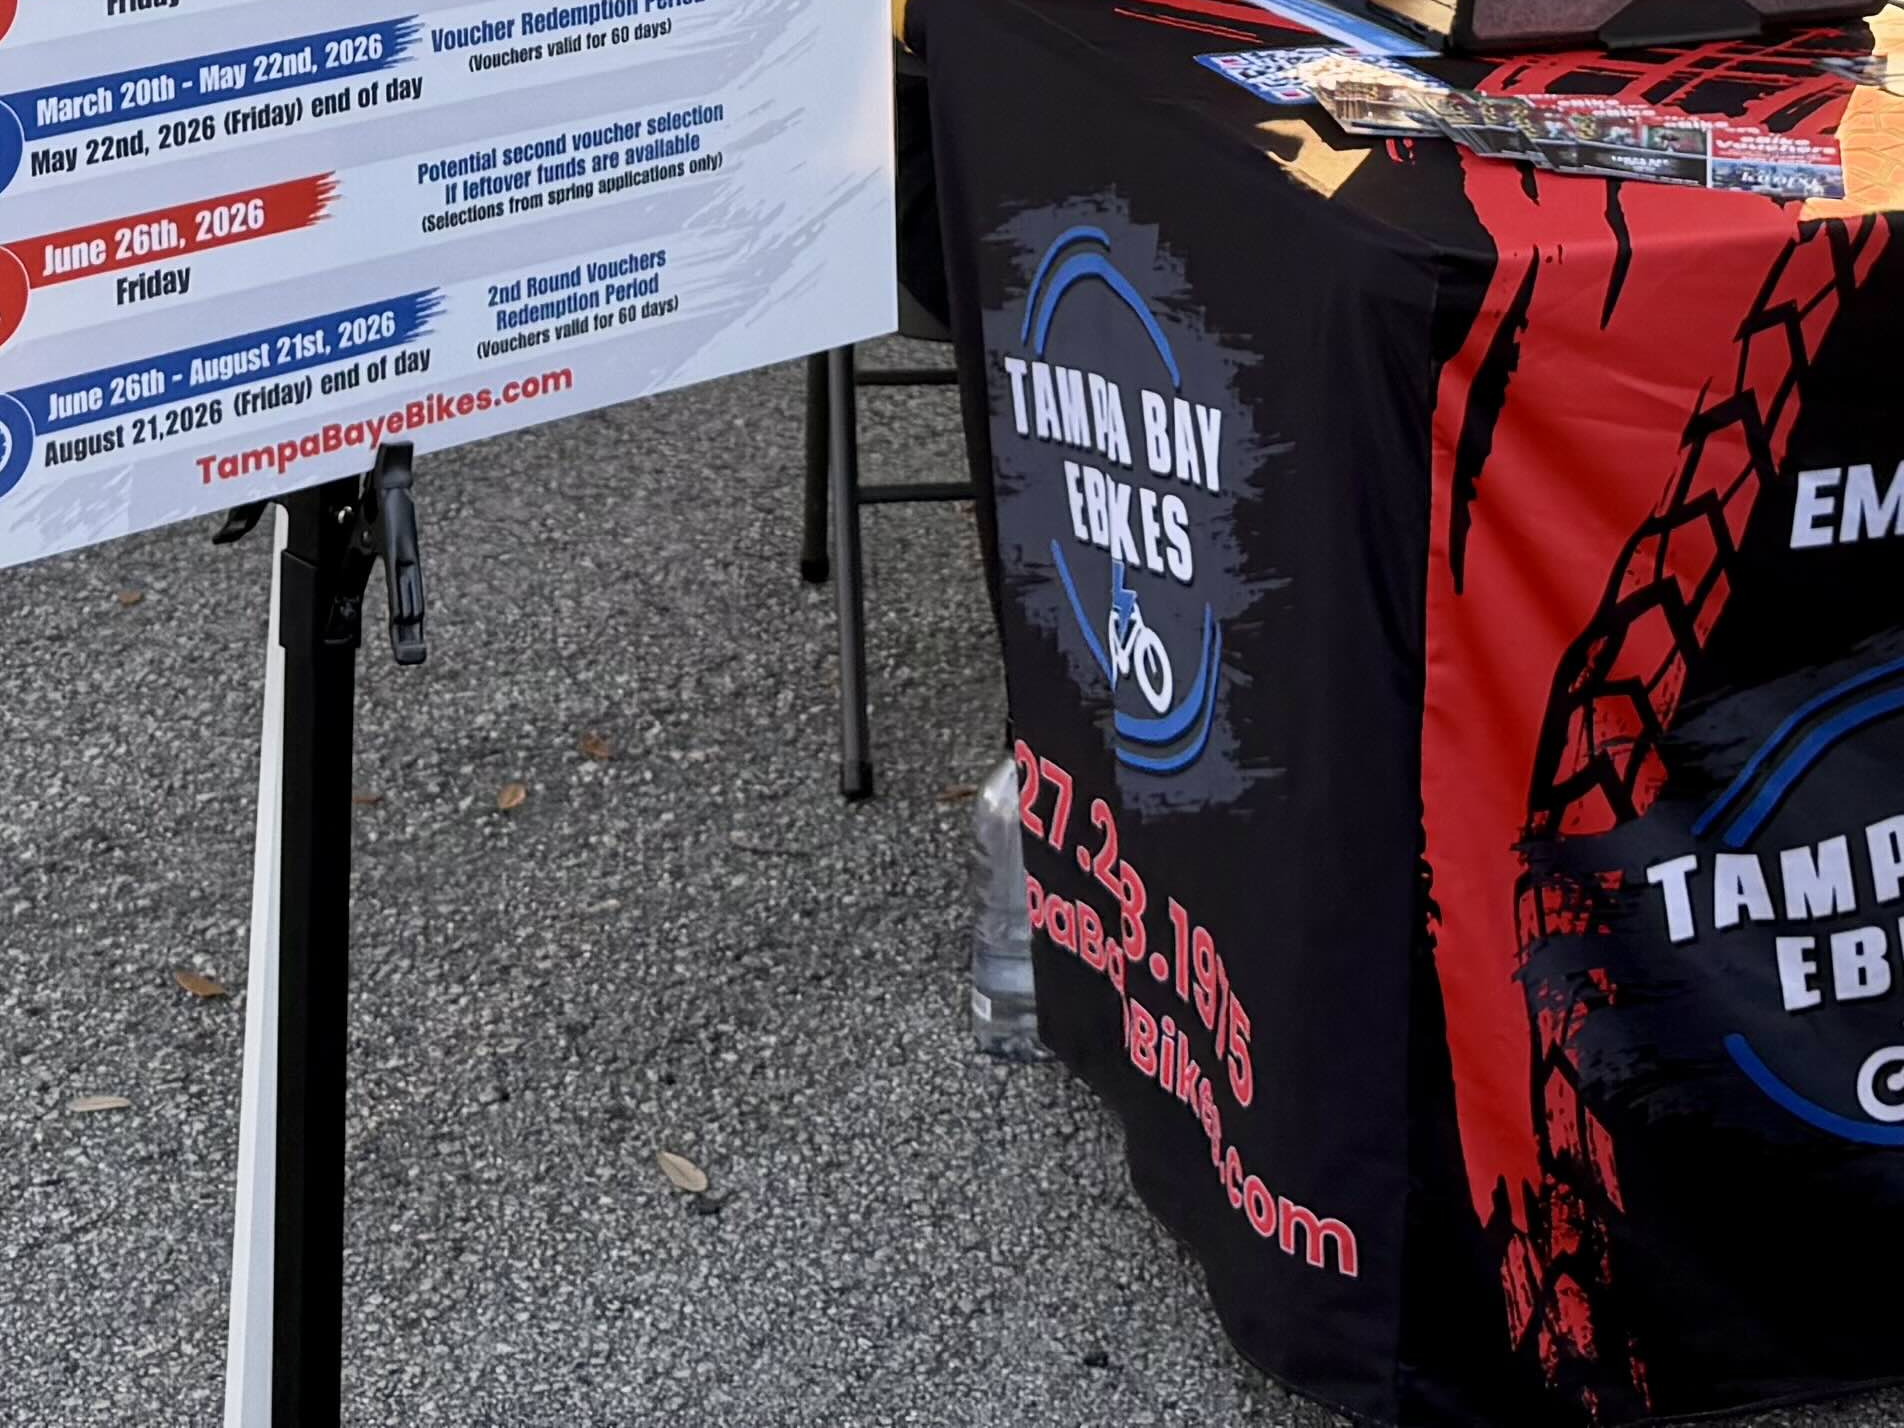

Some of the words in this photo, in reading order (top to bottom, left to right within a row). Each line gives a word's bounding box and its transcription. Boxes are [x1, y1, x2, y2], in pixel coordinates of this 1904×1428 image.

[430, 17, 516, 54] Voucher
[468, 44, 543, 75] (Vouchers
[547, 36, 582, 57] valid
[585, 30, 608, 51] for
[611, 26, 630, 46] 60
[634, 17, 673, 42] days)
[36, 87, 114, 127] March
[119, 76, 176, 108] 20th
[199, 64, 247, 95] May
[252, 46, 318, 84] 22nd,
[325, 33, 384, 70] 2026
[417, 148, 497, 185] Potential
[502, 134, 567, 165] second
[572, 120, 642, 152] voucher
[646, 103, 724, 137] selection
[463, 170, 532, 200] leftover
[537, 156, 587, 184] funds
[591, 150, 620, 173] are
[625, 133, 700, 165] available
[421, 199, 505, 233] (Selections
[508, 192, 544, 216] from
[547, 182, 594, 206] spring
[598, 164, 684, 198] applications
[689, 151, 724, 175] only)
[42, 240, 108, 278] June
[115, 220, 186, 261] 26th,
[195, 198, 265, 242] 2026
[487, 280, 522, 307] 2nd
[526, 265, 582, 296] Round
[586, 249, 667, 283] Vouchers
[115, 266, 192, 306] Friday
[496, 293, 601, 332] Redemption
[605, 272, 660, 303] Period
[47, 388, 104, 423] June
[109, 369, 165, 406] 26th
[189, 344, 271, 388] August
[276, 329, 331, 363] 21st,
[338, 310, 397, 349] 2026
[476, 329, 551, 360] (Vouchers
[554, 318, 590, 341] valid
[593, 311, 615, 332] for
[618, 305, 637, 325] 60
[640, 295, 680, 320] days)
[44, 426, 126, 468] August
[233, 375, 314, 418] (Friday)
[319, 365, 361, 394] end
[366, 352, 388, 383] of
[394, 348, 433, 379] day
[195, 365, 575, 486] TampaBayeBikes.com
[1004, 355, 1133, 468] TAMPA
[1141, 388, 1222, 493] BAY
